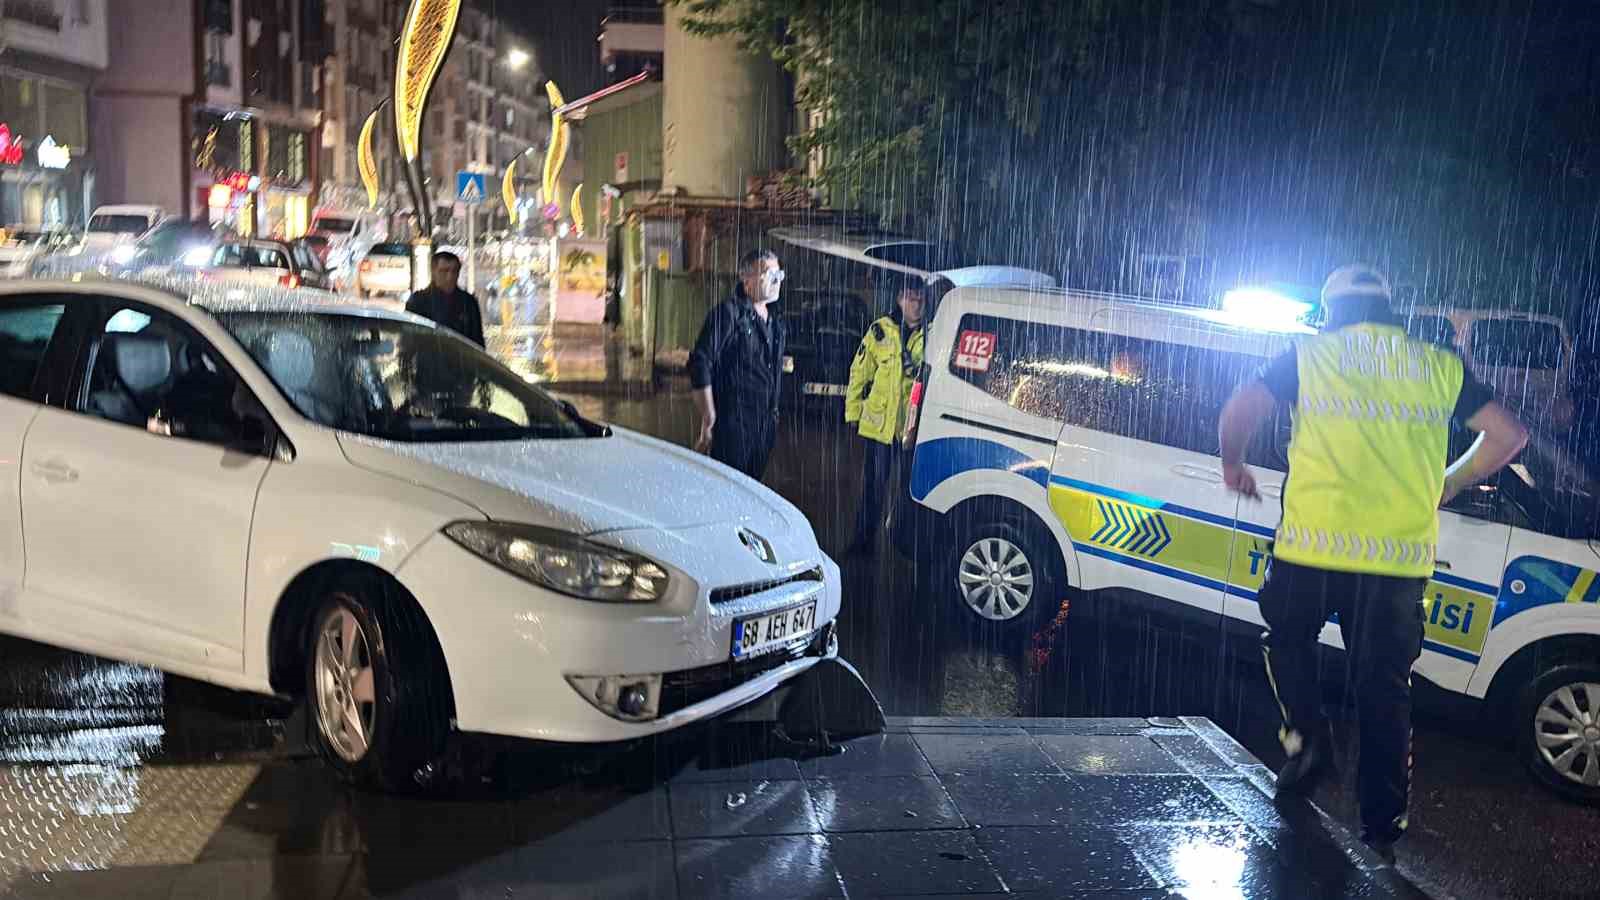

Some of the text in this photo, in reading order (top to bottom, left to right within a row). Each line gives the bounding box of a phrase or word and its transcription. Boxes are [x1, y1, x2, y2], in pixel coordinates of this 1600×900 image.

[963, 334, 990, 357] 112
[742, 605, 813, 649] 68 AEH 647
